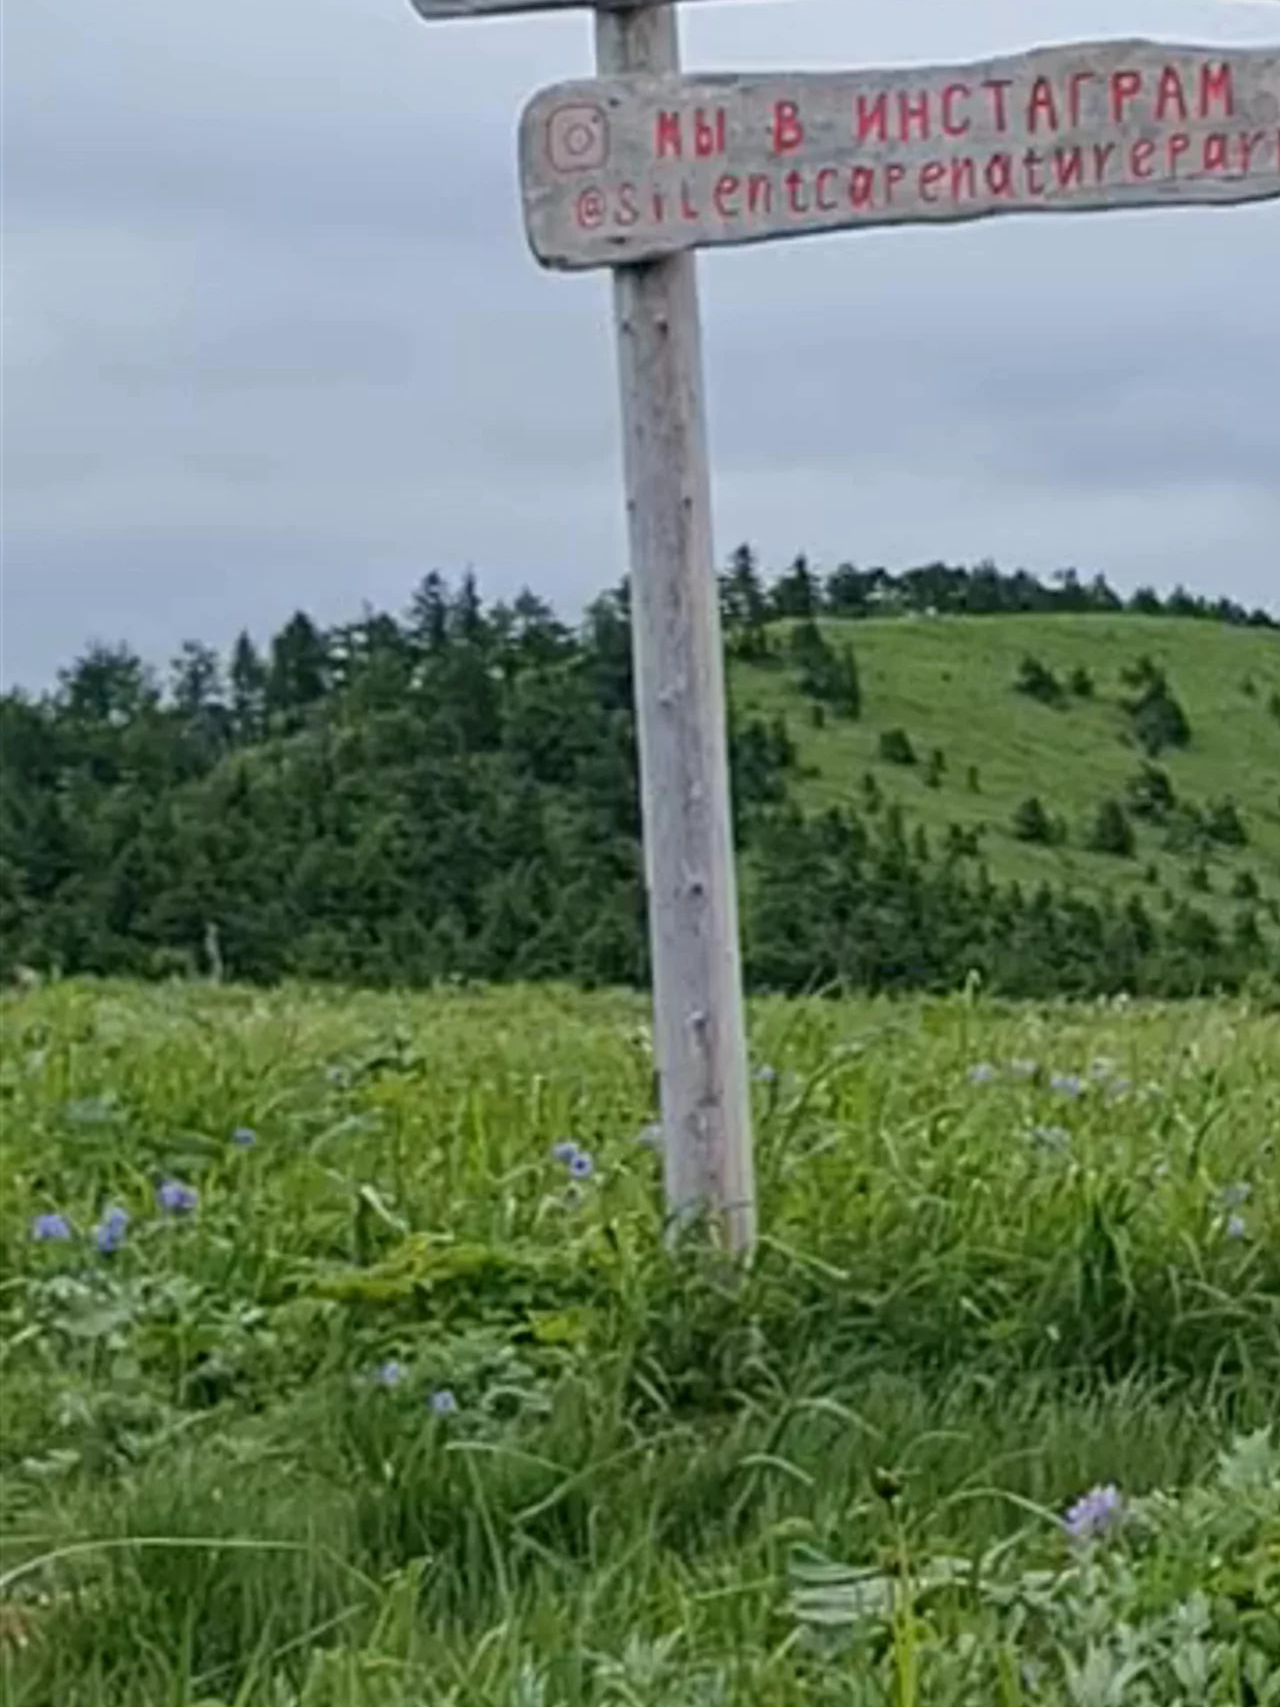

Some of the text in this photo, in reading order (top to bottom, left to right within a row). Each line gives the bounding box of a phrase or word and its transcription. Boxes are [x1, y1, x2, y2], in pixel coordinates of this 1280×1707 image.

[654, 61, 1236, 159] МЫ В ИНСТАГРАМ
